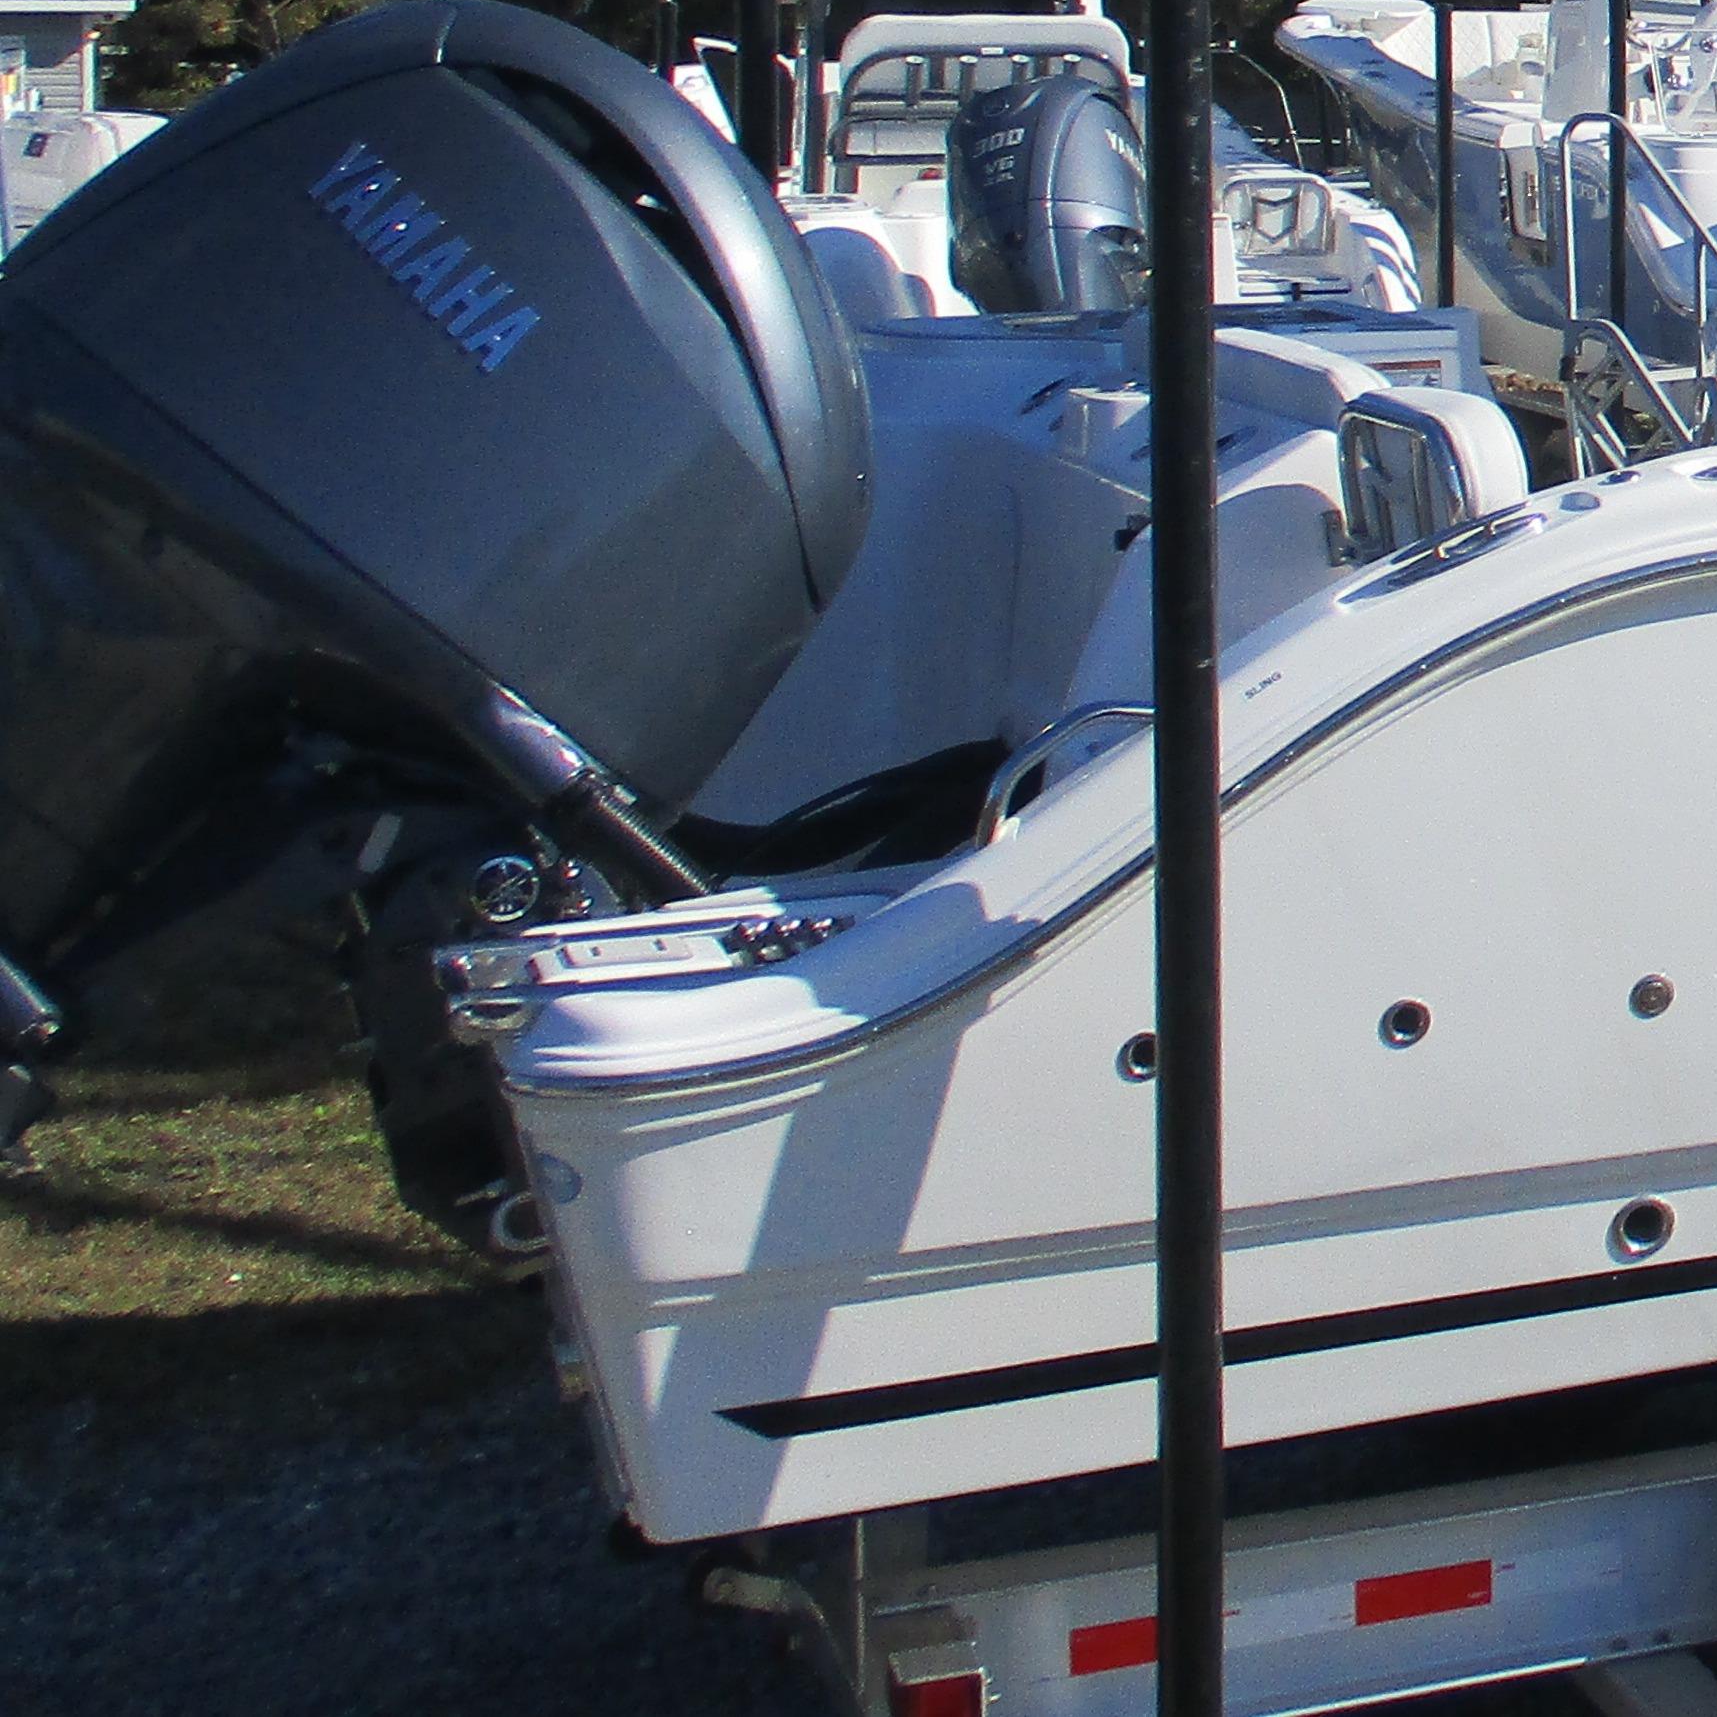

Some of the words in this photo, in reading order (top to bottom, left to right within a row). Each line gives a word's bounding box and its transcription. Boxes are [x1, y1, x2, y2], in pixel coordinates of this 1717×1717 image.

[972, 128, 1025, 158] 300
[306, 140, 543, 373] YAMAHA
[1244, 671, 1282, 700] SLING
